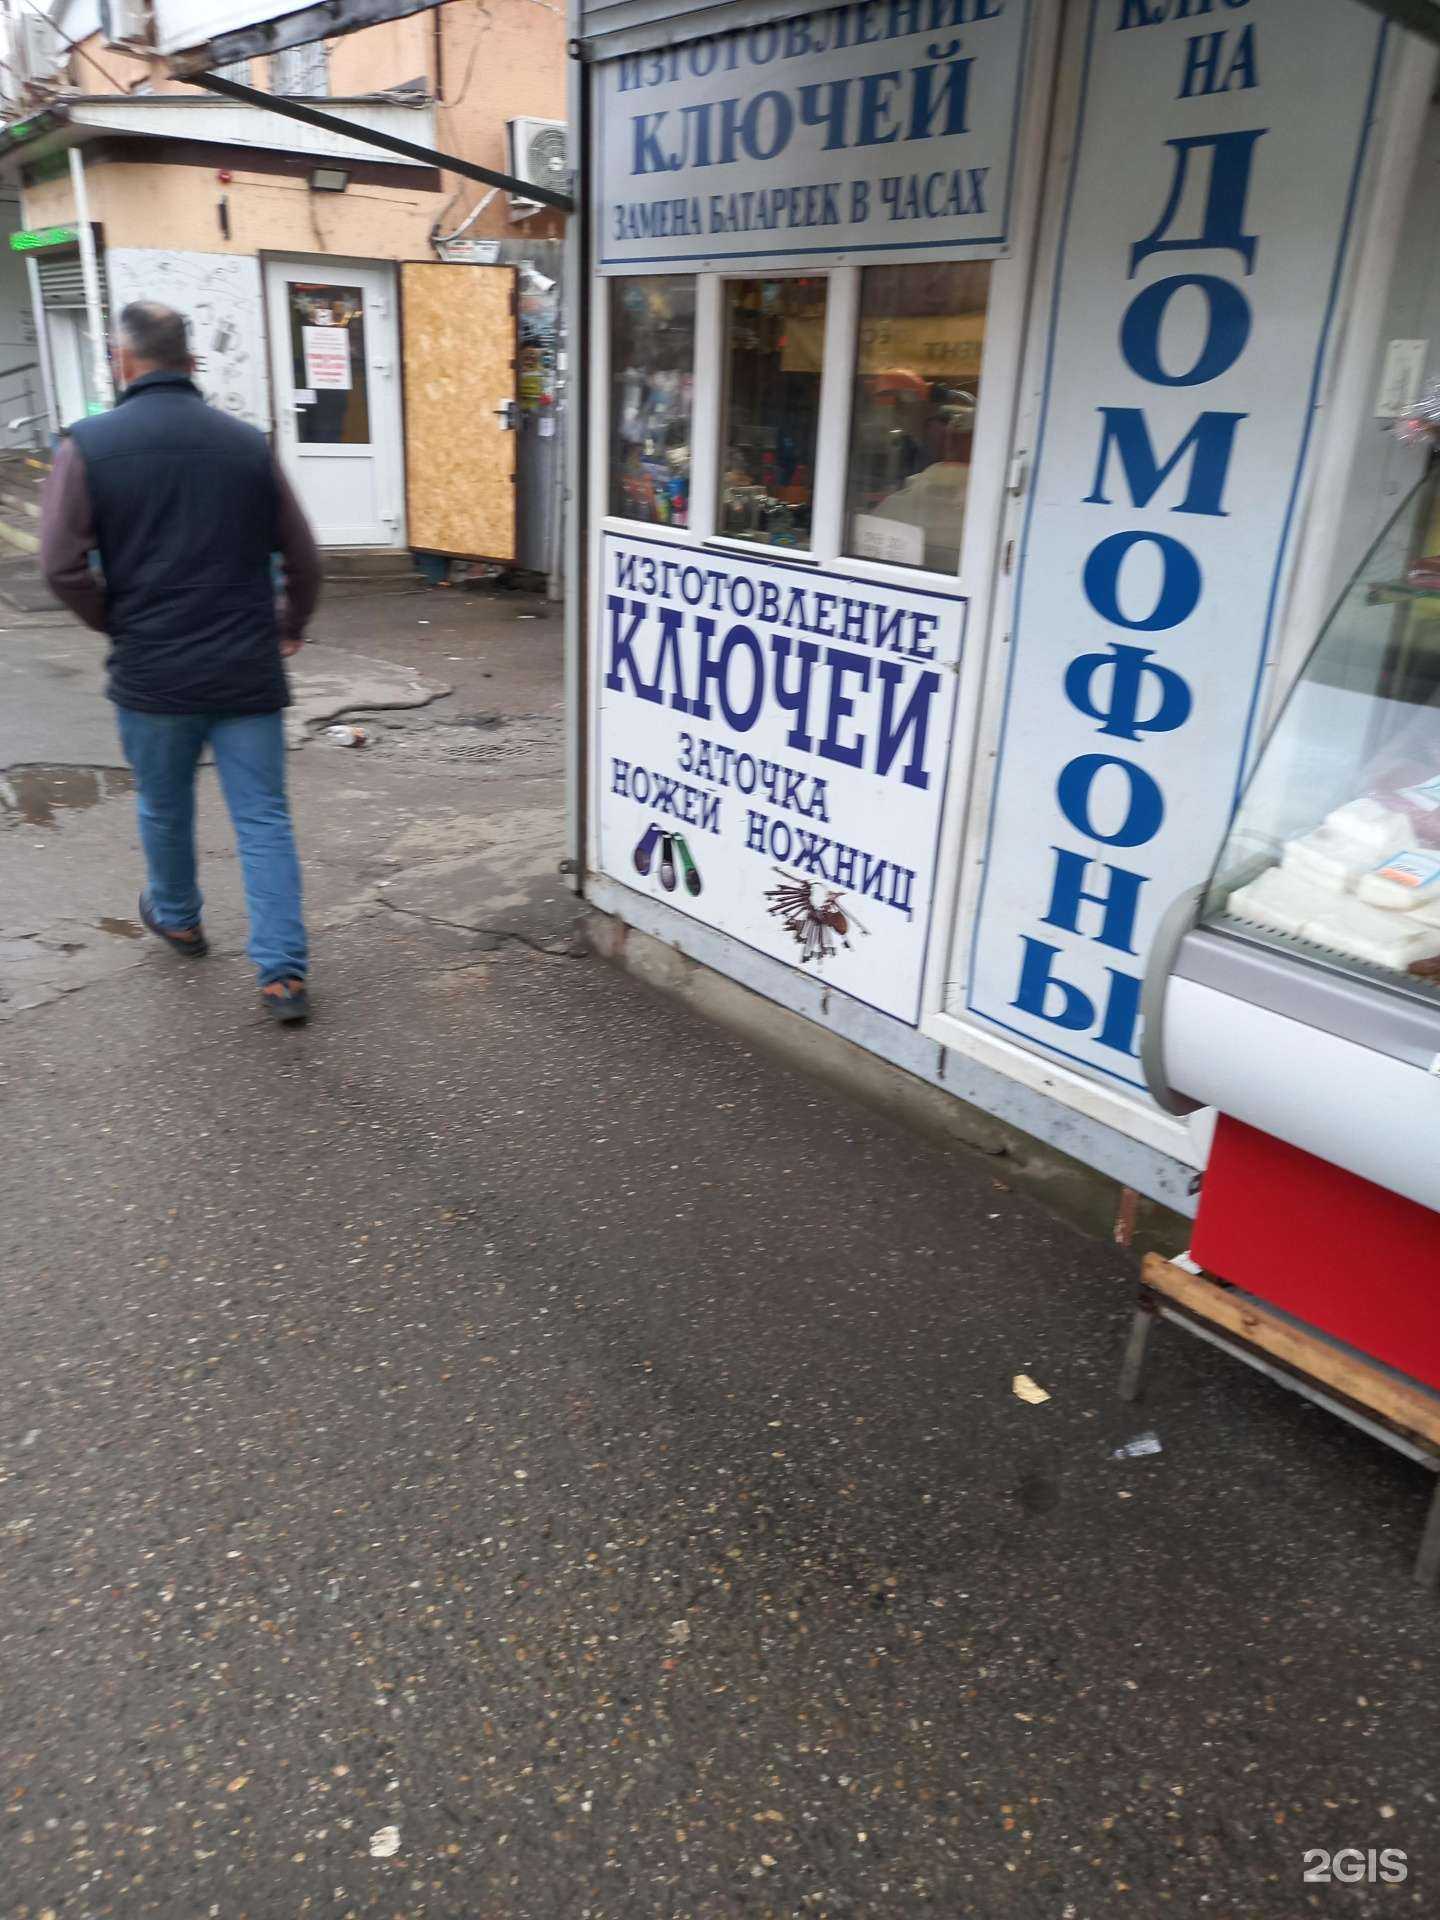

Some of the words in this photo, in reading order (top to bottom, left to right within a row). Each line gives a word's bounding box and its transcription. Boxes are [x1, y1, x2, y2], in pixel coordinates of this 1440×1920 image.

[629, 39, 978, 176] КЛЮЧЕЙ
[1174, 22, 1259, 100] НА
[613, 198, 702, 241] ЗАМЕНА
[708, 181, 841, 234] БАТАРЕЕК
[849, 181, 872, 224] В
[880, 166, 991, 222] ЧАСАХ
[614, 550, 938, 660] ИЗГОТОВЛЕНИЕ
[1009, 127, 1270, 1058] ДОМОФОНЫ
[678, 731, 829, 823] ЗАТОЧКА
[610, 757, 721, 834] НОЖЕЙ
[744, 809, 916, 922] НОЖНИЦ
